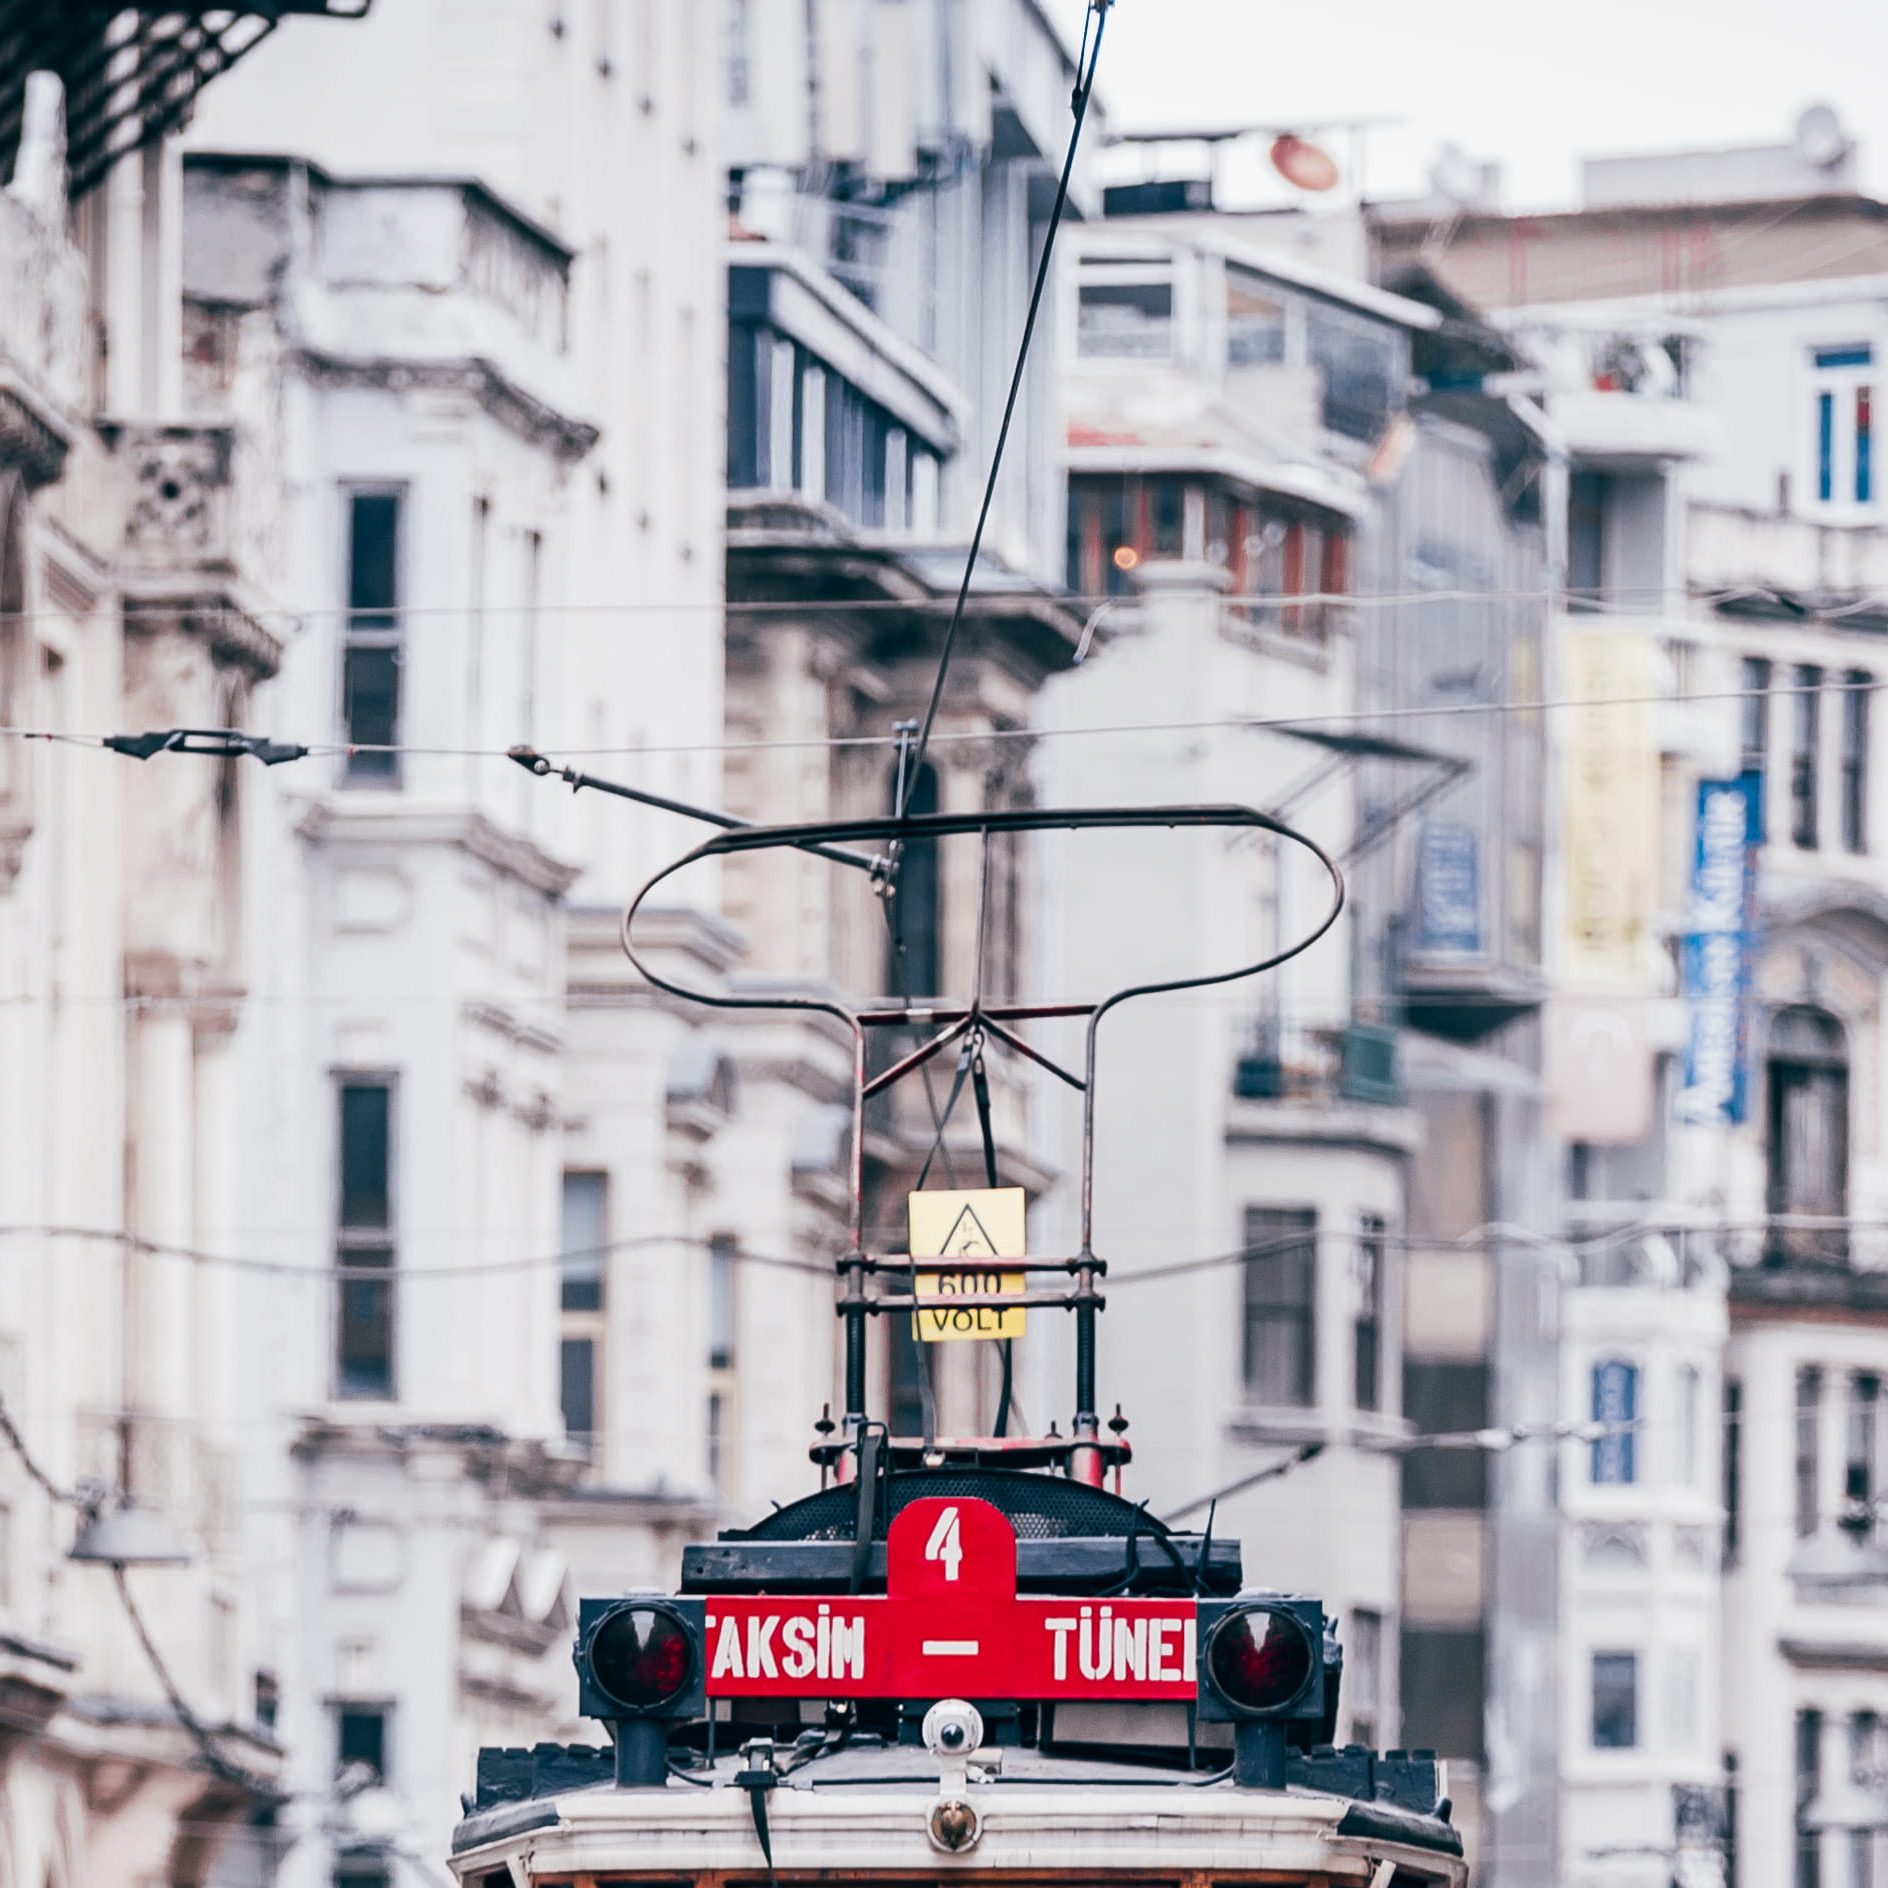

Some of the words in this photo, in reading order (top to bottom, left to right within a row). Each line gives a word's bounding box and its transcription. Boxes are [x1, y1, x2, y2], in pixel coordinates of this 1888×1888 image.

[937, 1272, 1002, 1297] 600
[932, 1307, 1005, 1331] VOLT
[925, 1506, 962, 1581] 4
